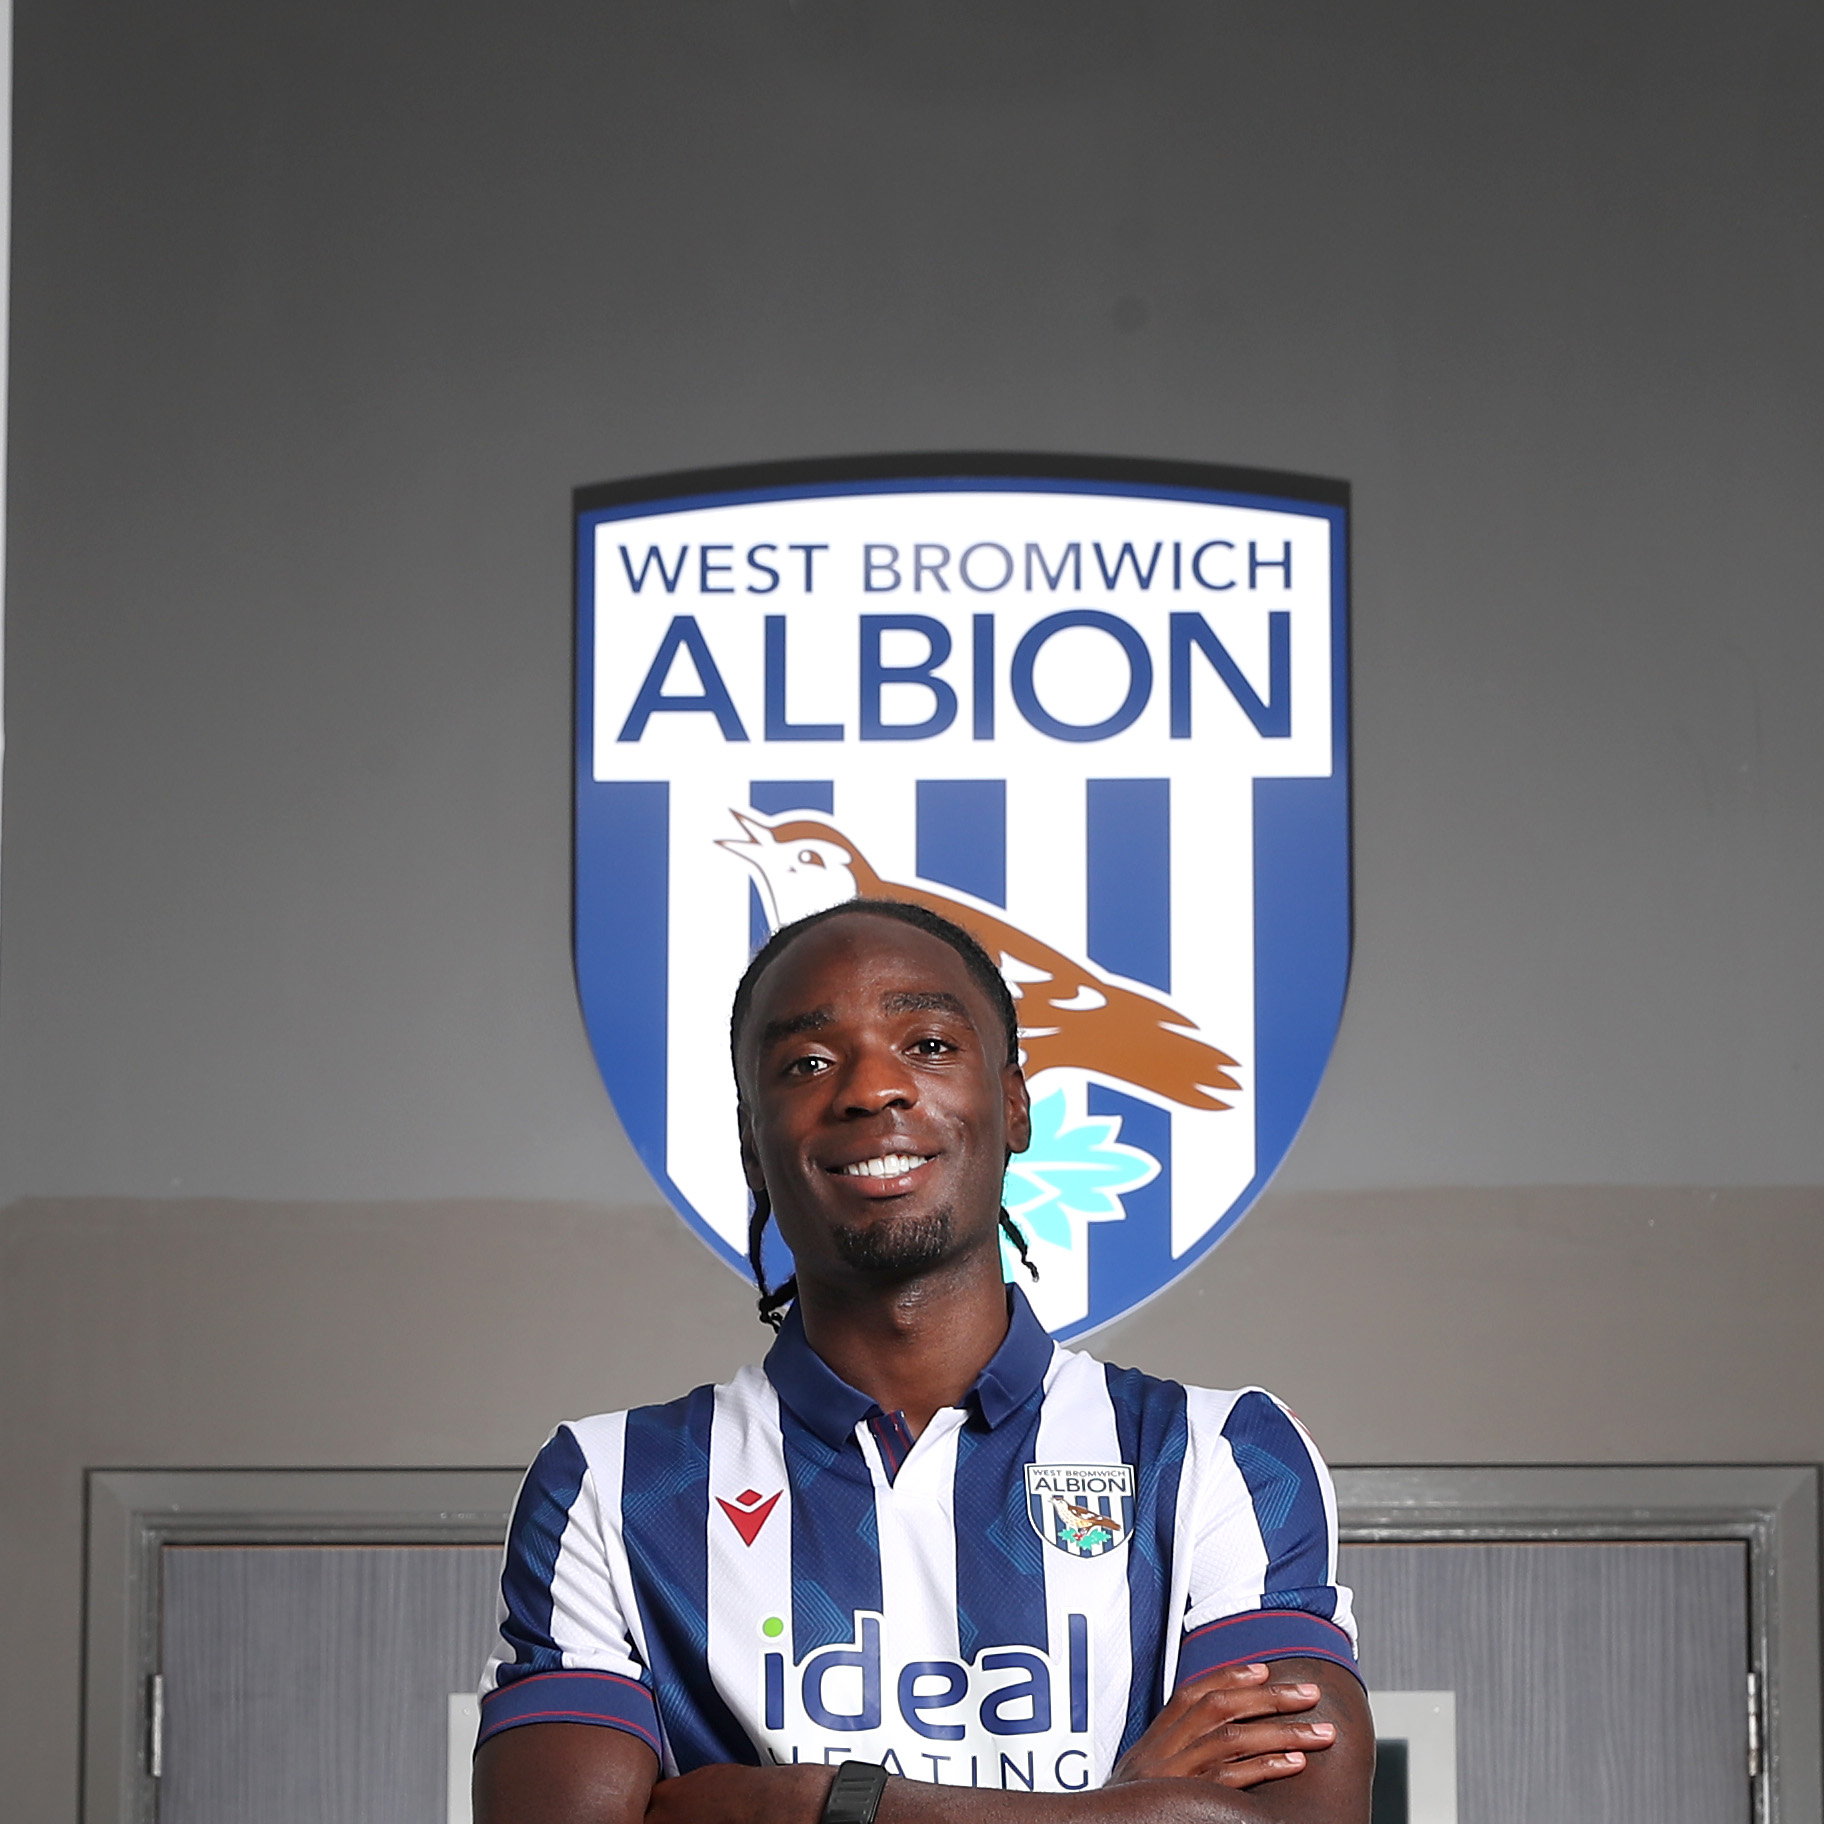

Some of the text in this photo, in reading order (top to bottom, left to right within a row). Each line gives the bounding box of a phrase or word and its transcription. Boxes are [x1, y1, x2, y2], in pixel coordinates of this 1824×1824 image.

[618, 539, 1293, 595] WEST BROMWICH
[616, 608, 1292, 742] ALBION
[1033, 1469, 1126, 1478] WEST BROMWICH
[1034, 1477, 1127, 1493] ALBION
[762, 1613, 1089, 1741] ideal
